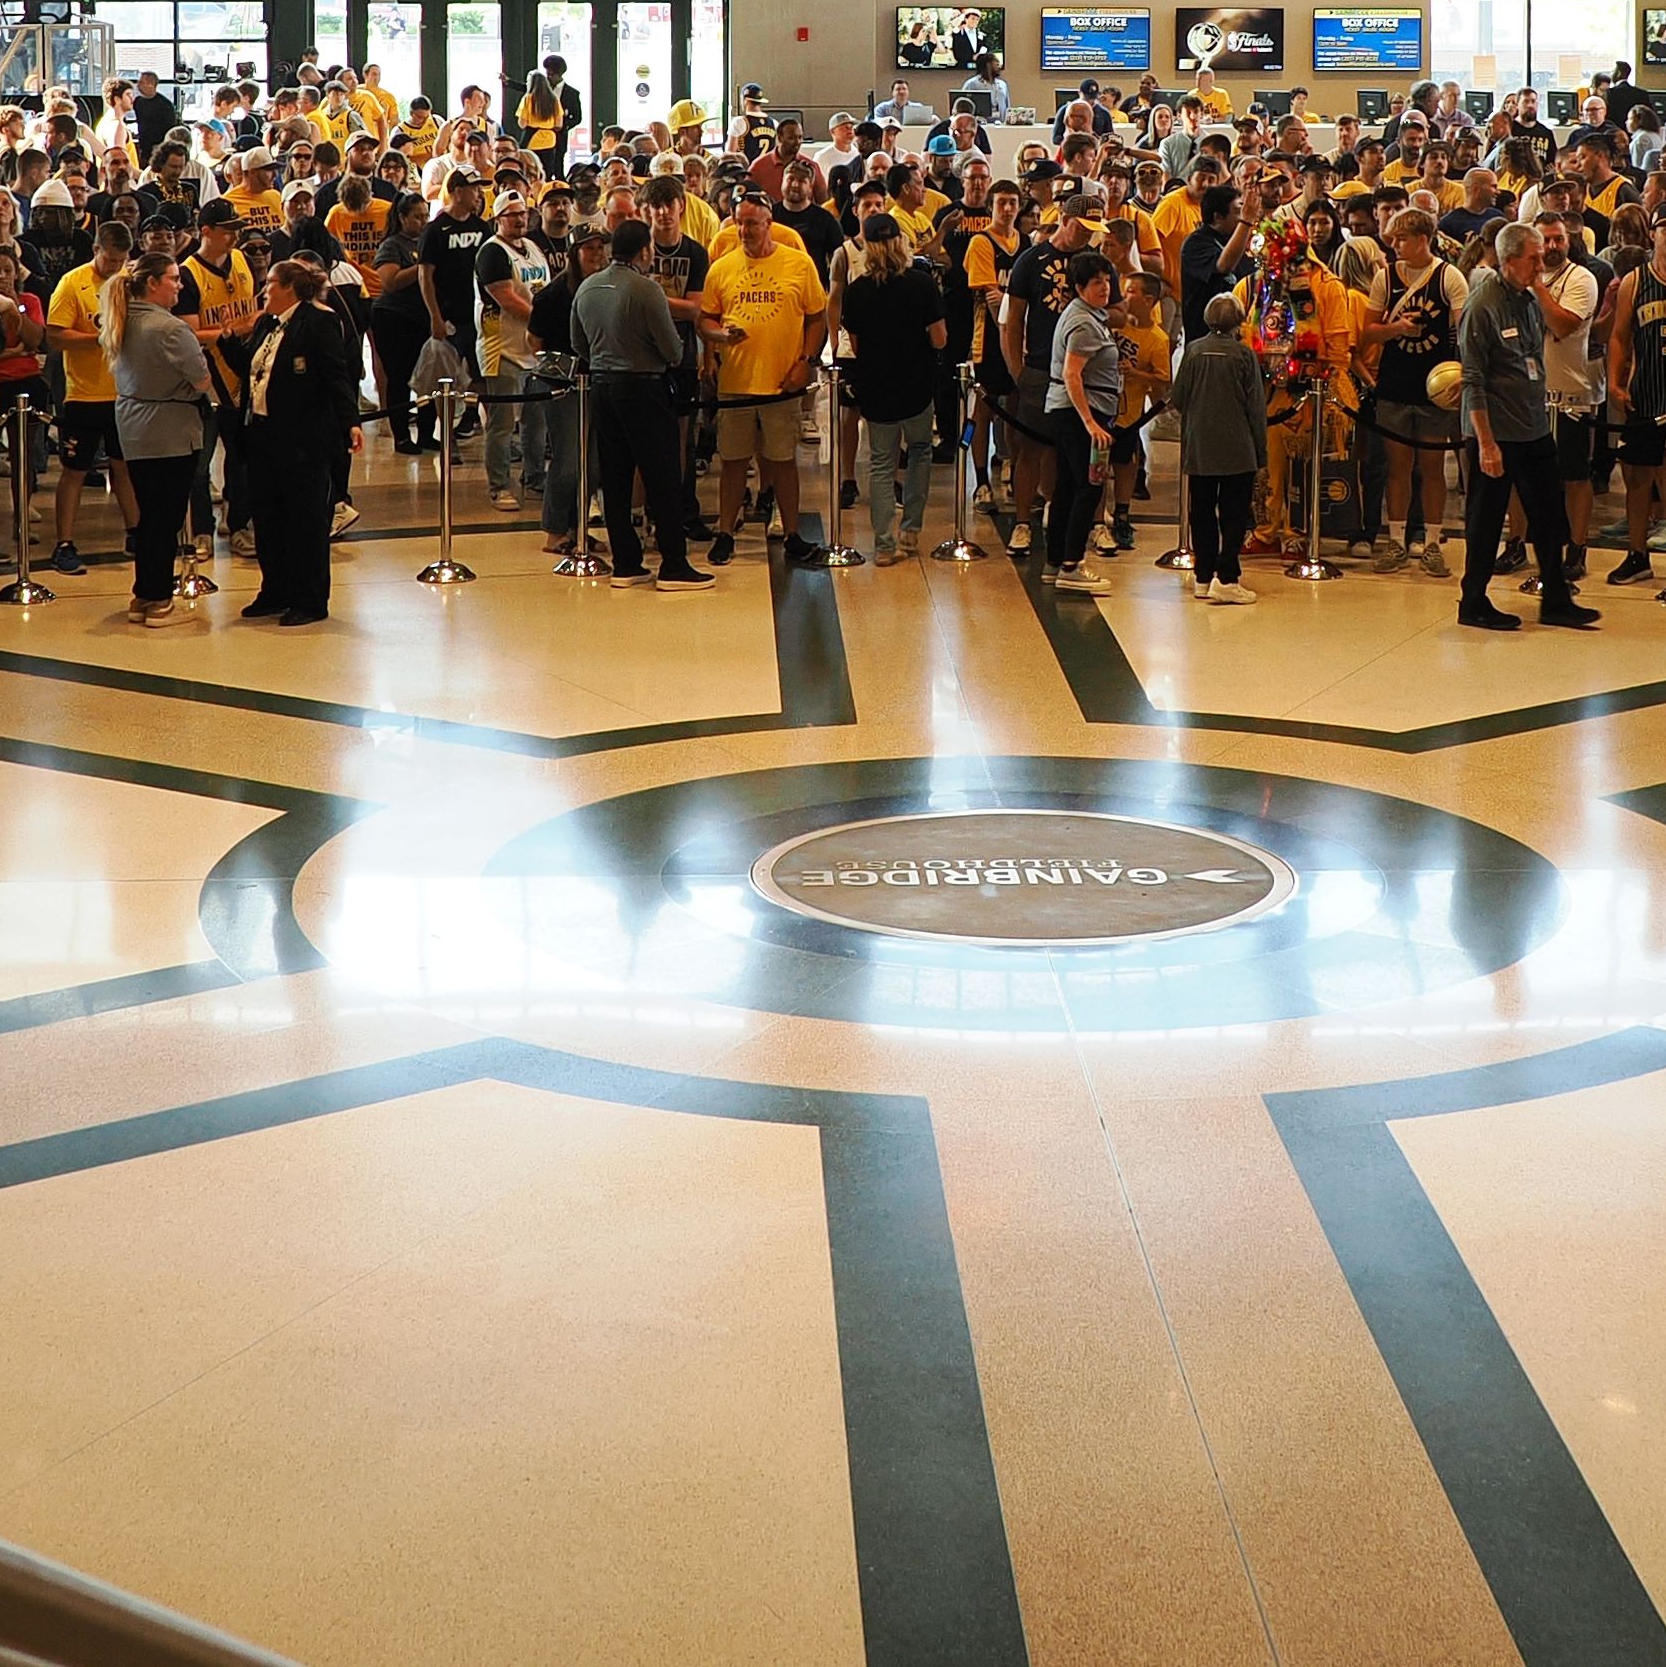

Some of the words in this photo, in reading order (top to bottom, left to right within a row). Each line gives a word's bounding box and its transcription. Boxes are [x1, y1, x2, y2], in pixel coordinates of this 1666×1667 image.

[1070, 17, 1092, 27] BOX
[1092, 17, 1127, 27] OFFICE
[1342, 18, 1363, 28] BOX
[1364, 18, 1399, 28] OFFICE
[1235, 31, 1275, 51] Finals
[250, 207, 270, 218] BUT
[351, 221, 375, 232] BUT
[343, 232, 371, 242] THIS
[448, 231, 484, 250] INDY
[740, 291, 776, 303] PACERS
[840, 859, 1121, 872] FIELDHOUSE
[806, 866, 1167, 886] GAINBRIDGE
